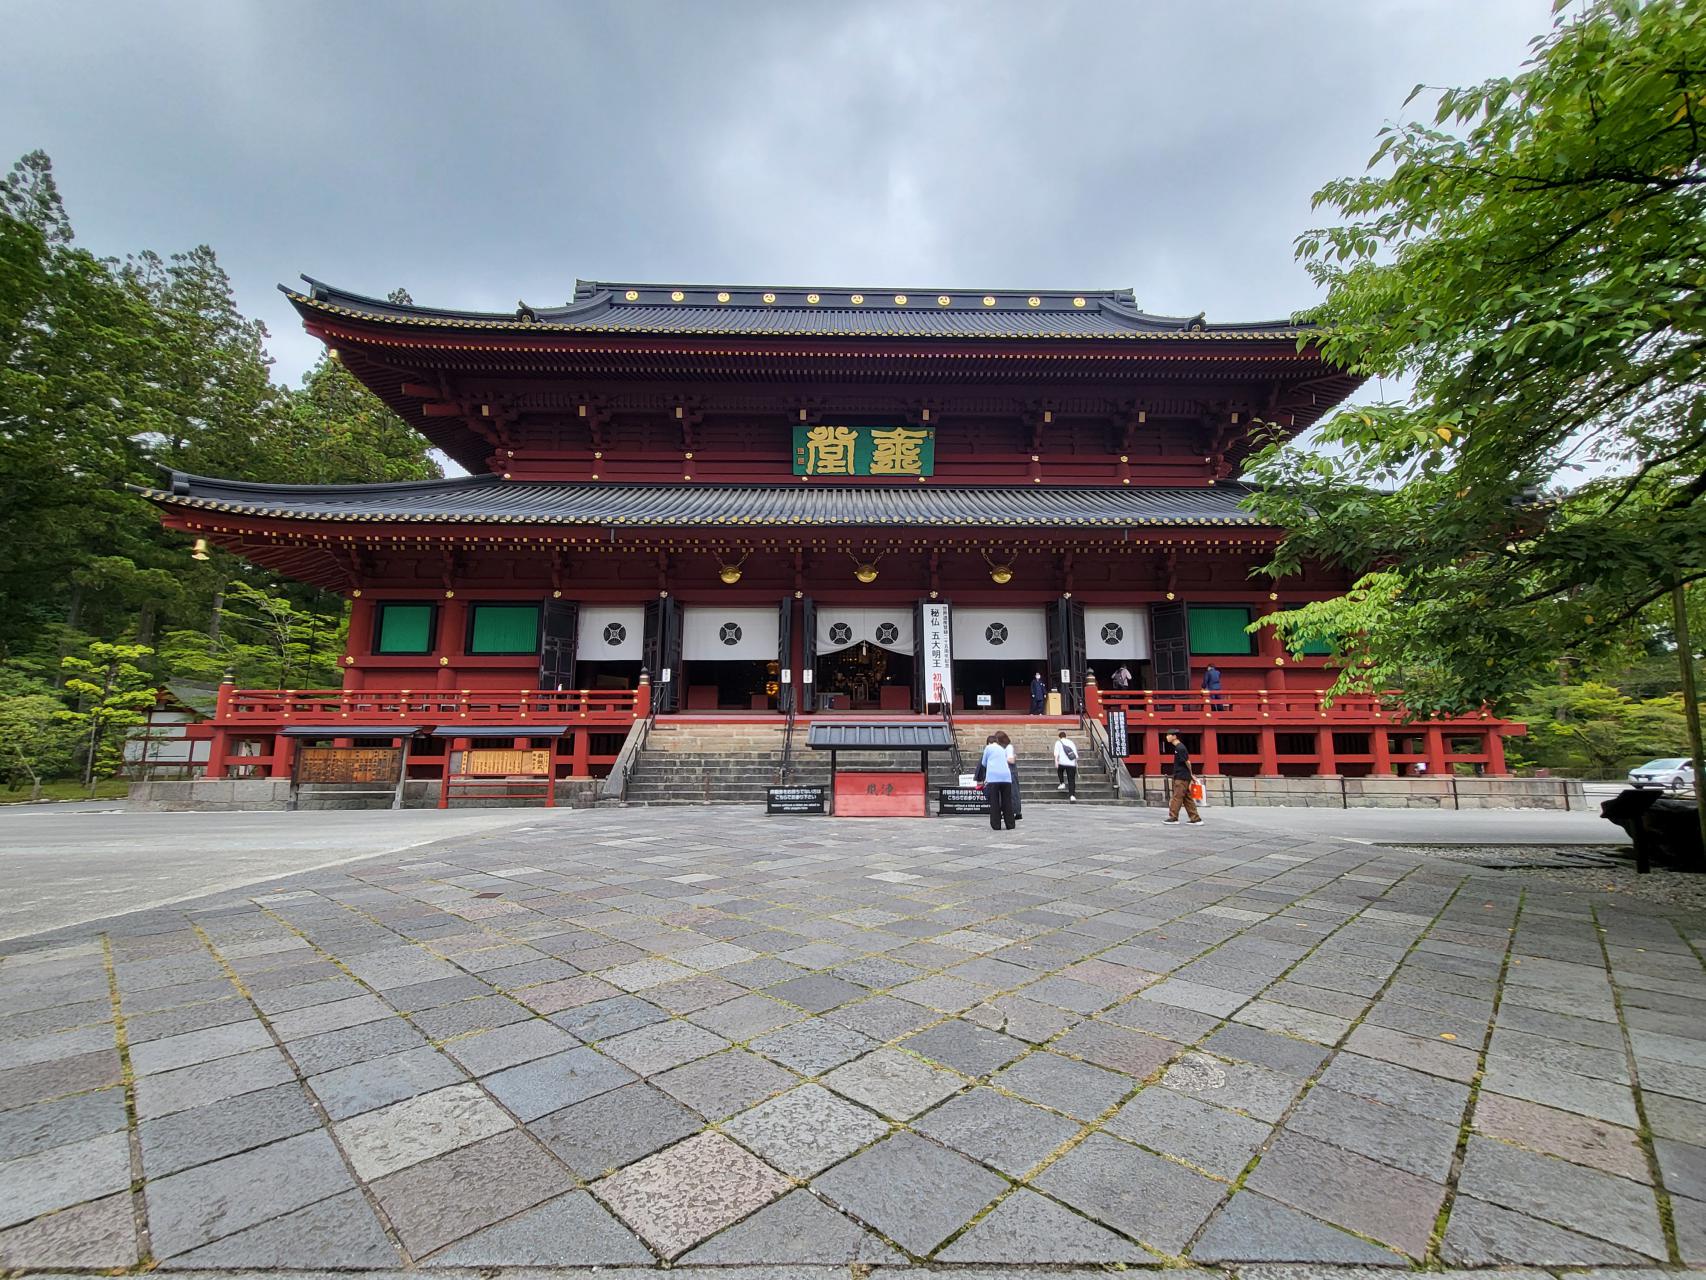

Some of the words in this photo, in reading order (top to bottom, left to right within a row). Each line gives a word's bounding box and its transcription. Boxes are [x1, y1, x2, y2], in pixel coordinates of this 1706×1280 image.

[930, 608, 940, 626] 秘仏
[931, 631, 942, 668] 五大明王
